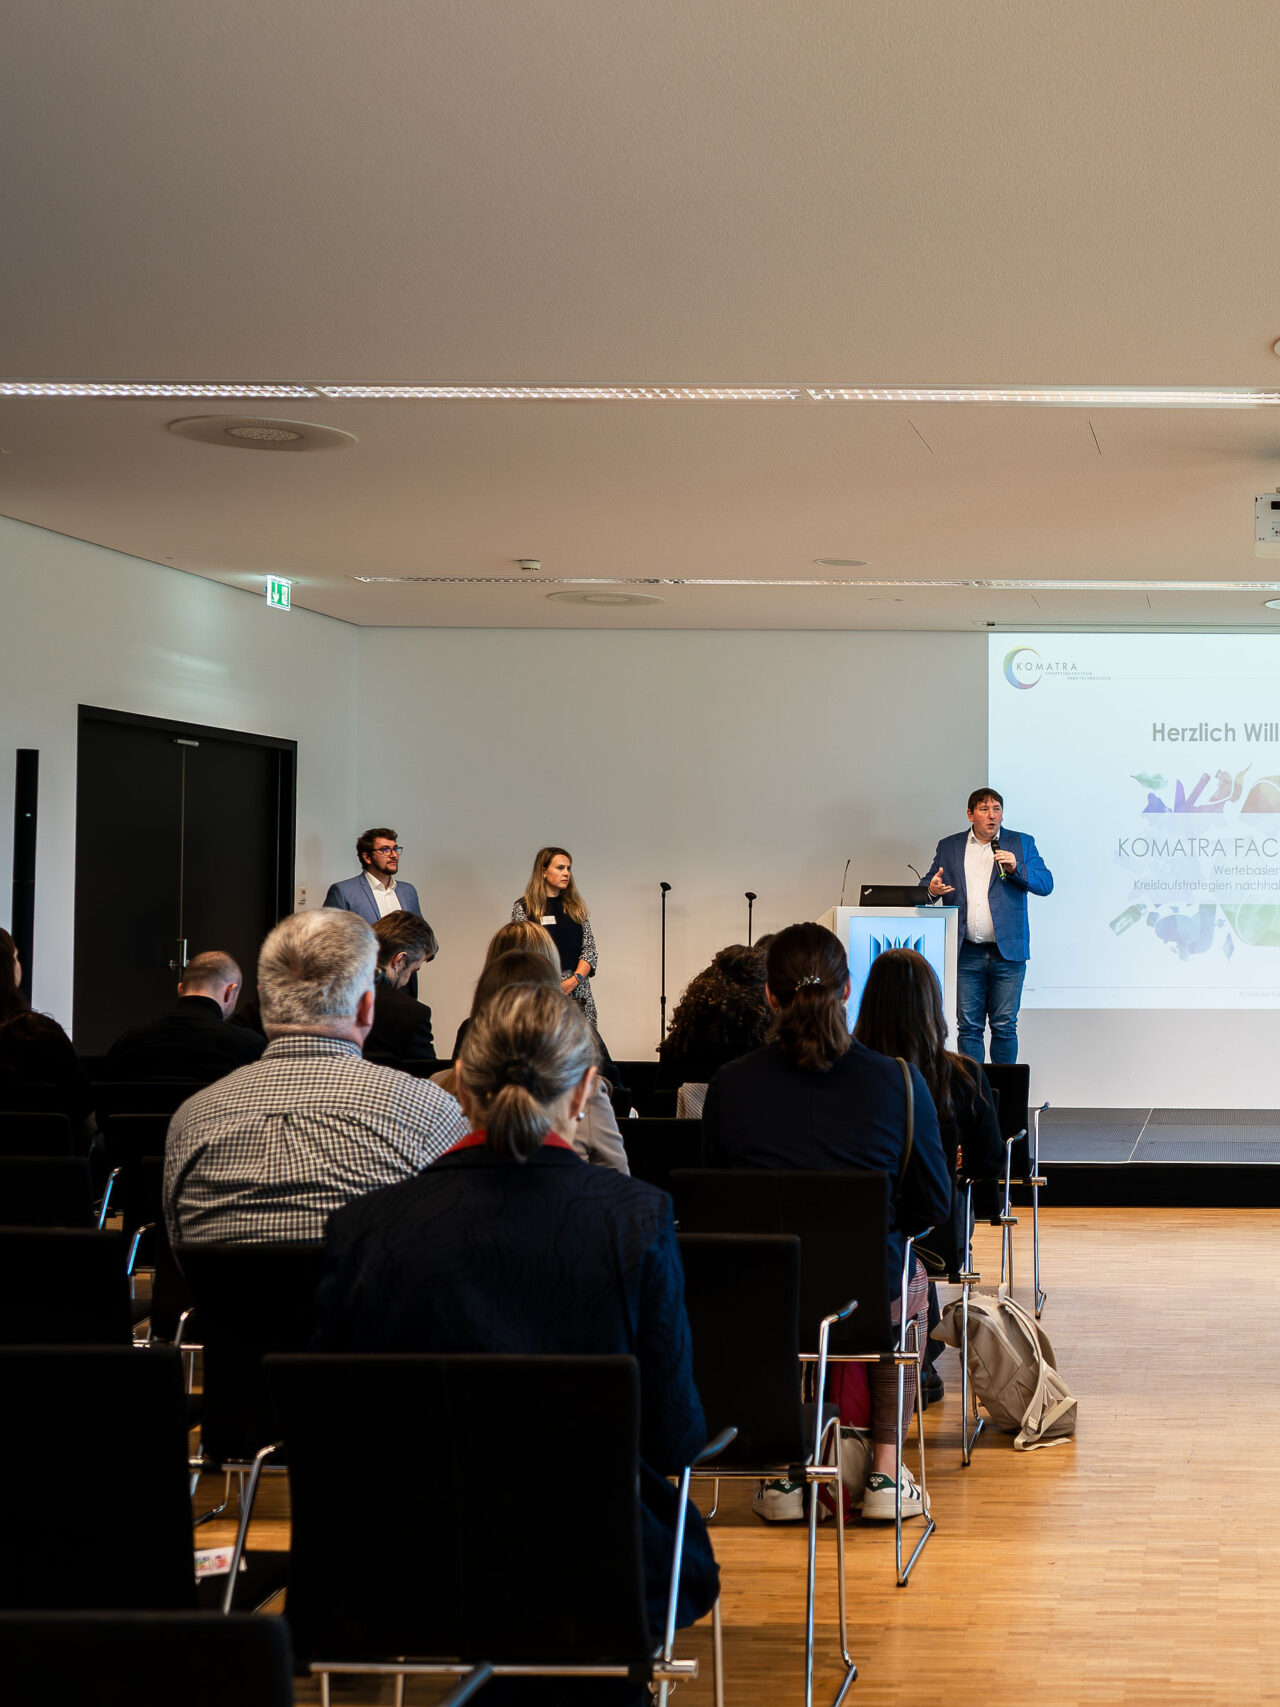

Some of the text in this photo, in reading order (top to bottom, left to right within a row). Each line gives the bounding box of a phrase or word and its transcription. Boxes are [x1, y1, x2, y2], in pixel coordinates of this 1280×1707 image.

[1016, 662, 1078, 671] KOMATRA
[1152, 722, 1236, 743] Herzlich
[1118, 837, 1227, 858] KOMATRA
[1133, 879, 1233, 893] Kreislaufstrategien
